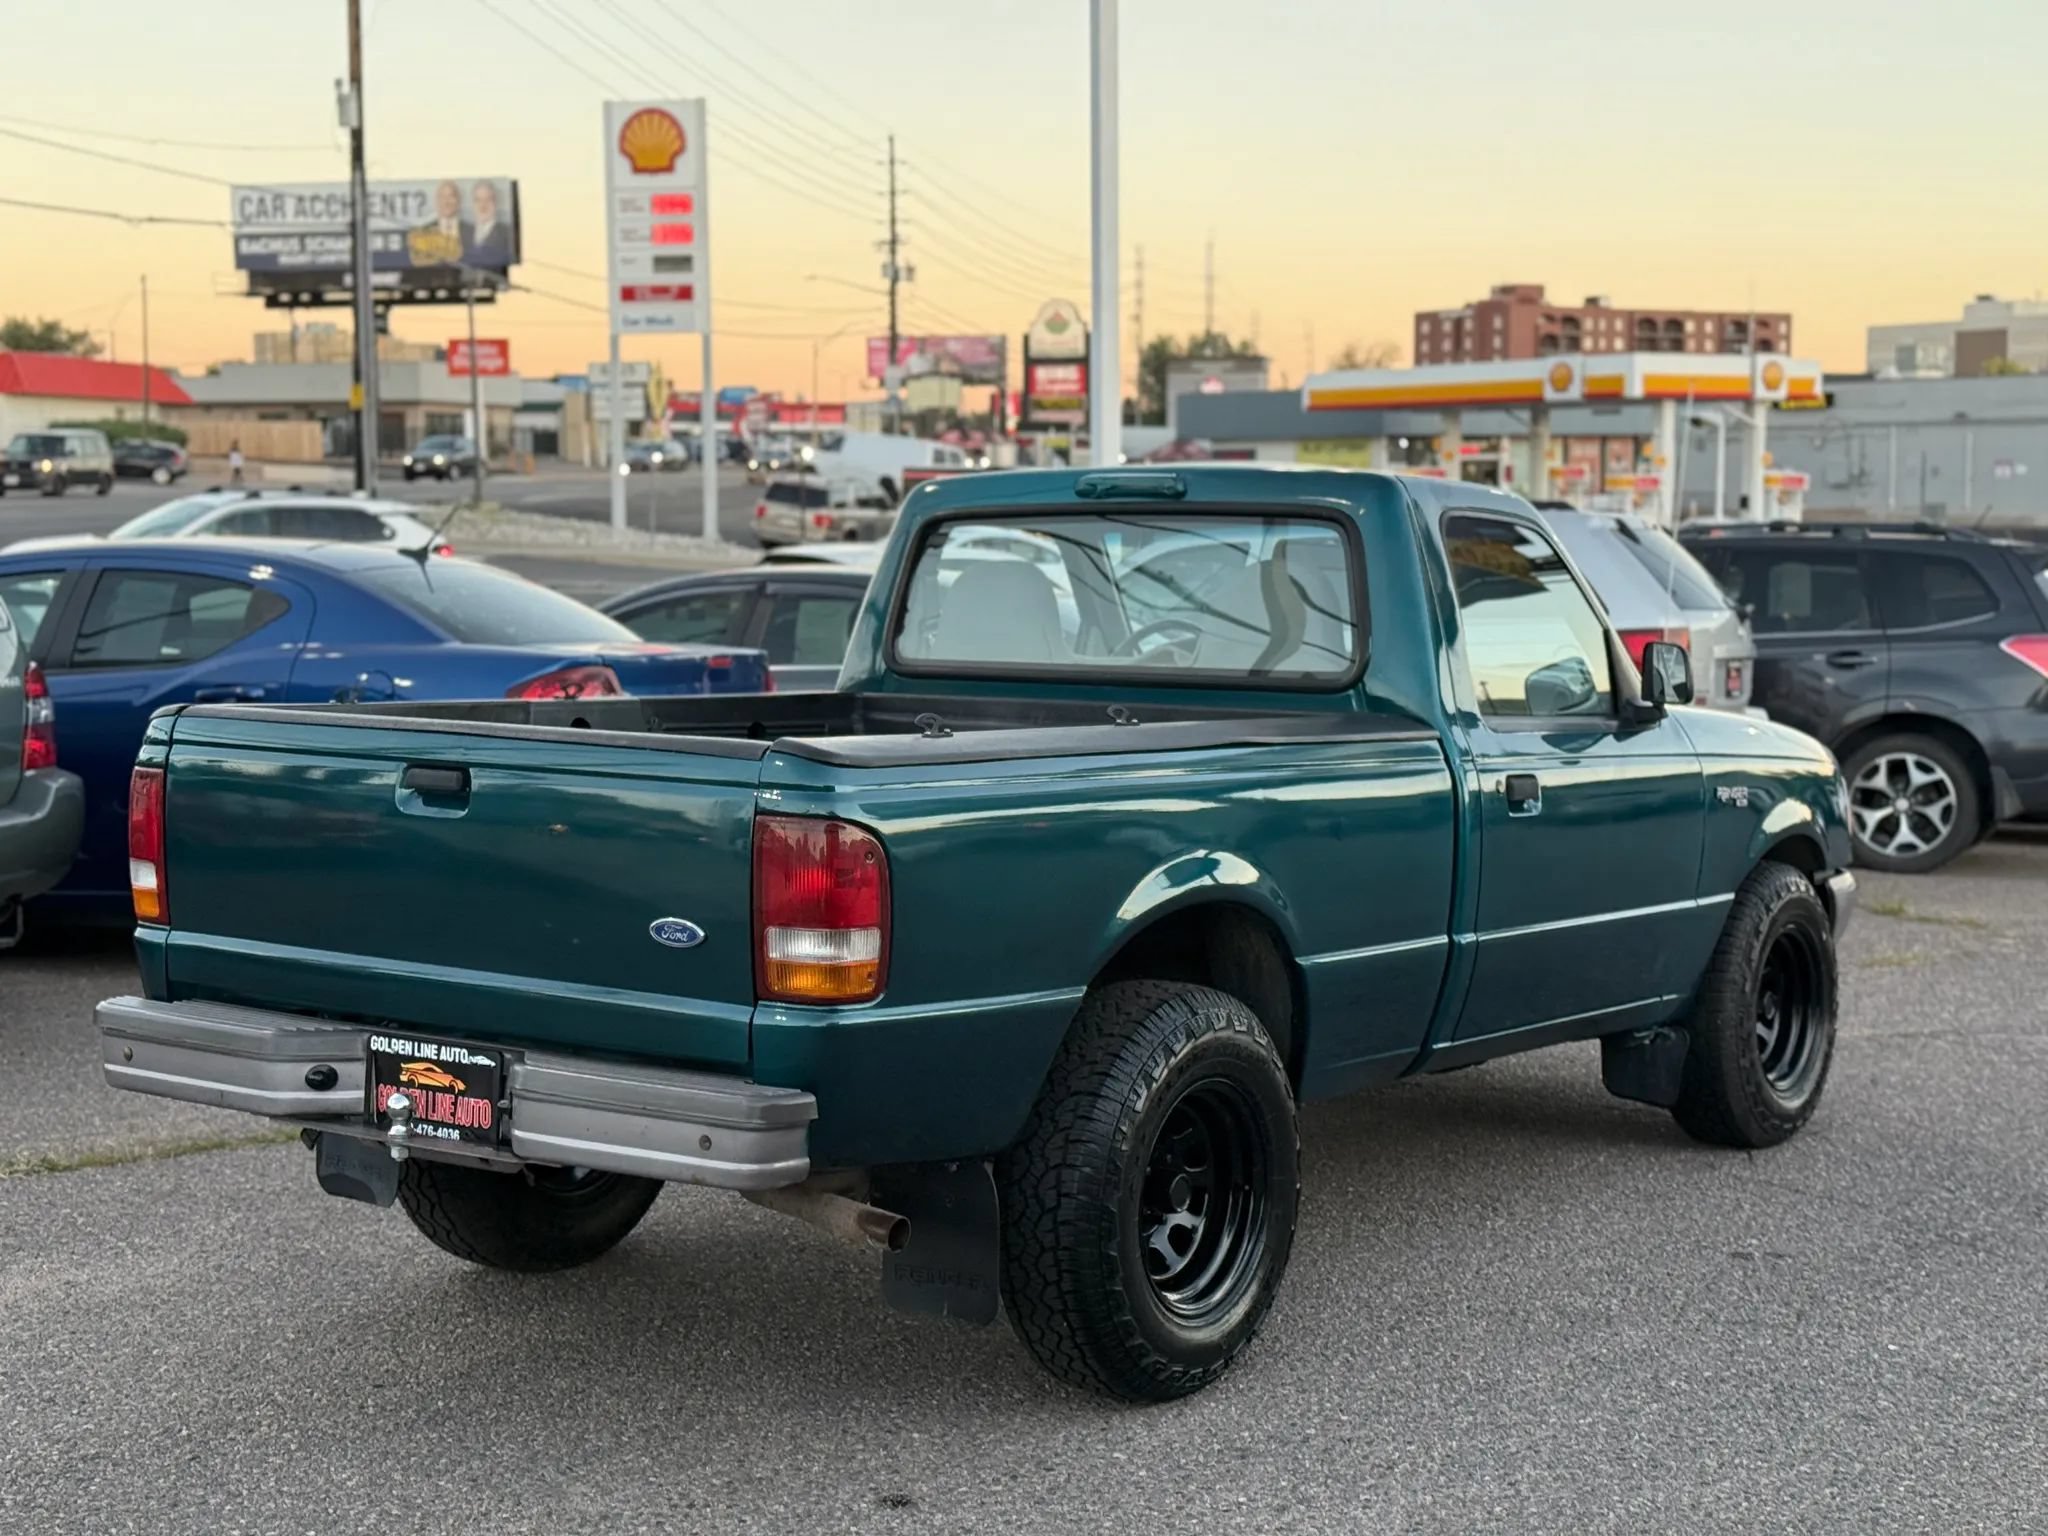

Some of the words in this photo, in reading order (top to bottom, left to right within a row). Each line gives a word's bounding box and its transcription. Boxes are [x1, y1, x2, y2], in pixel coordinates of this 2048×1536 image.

[239, 194, 287, 223] CAR
[294, 190, 427, 220] ACCIENT?
[661, 924, 690, 942] Ford
[370, 1035, 413, 1056] GOLDEN
[414, 1041, 438, 1060] LINE
[439, 1045, 469, 1064] AUTO
[377, 1082, 427, 1119] GOEN
[427, 1090, 456, 1123] LINE
[455, 1096, 492, 1129] AUTO
